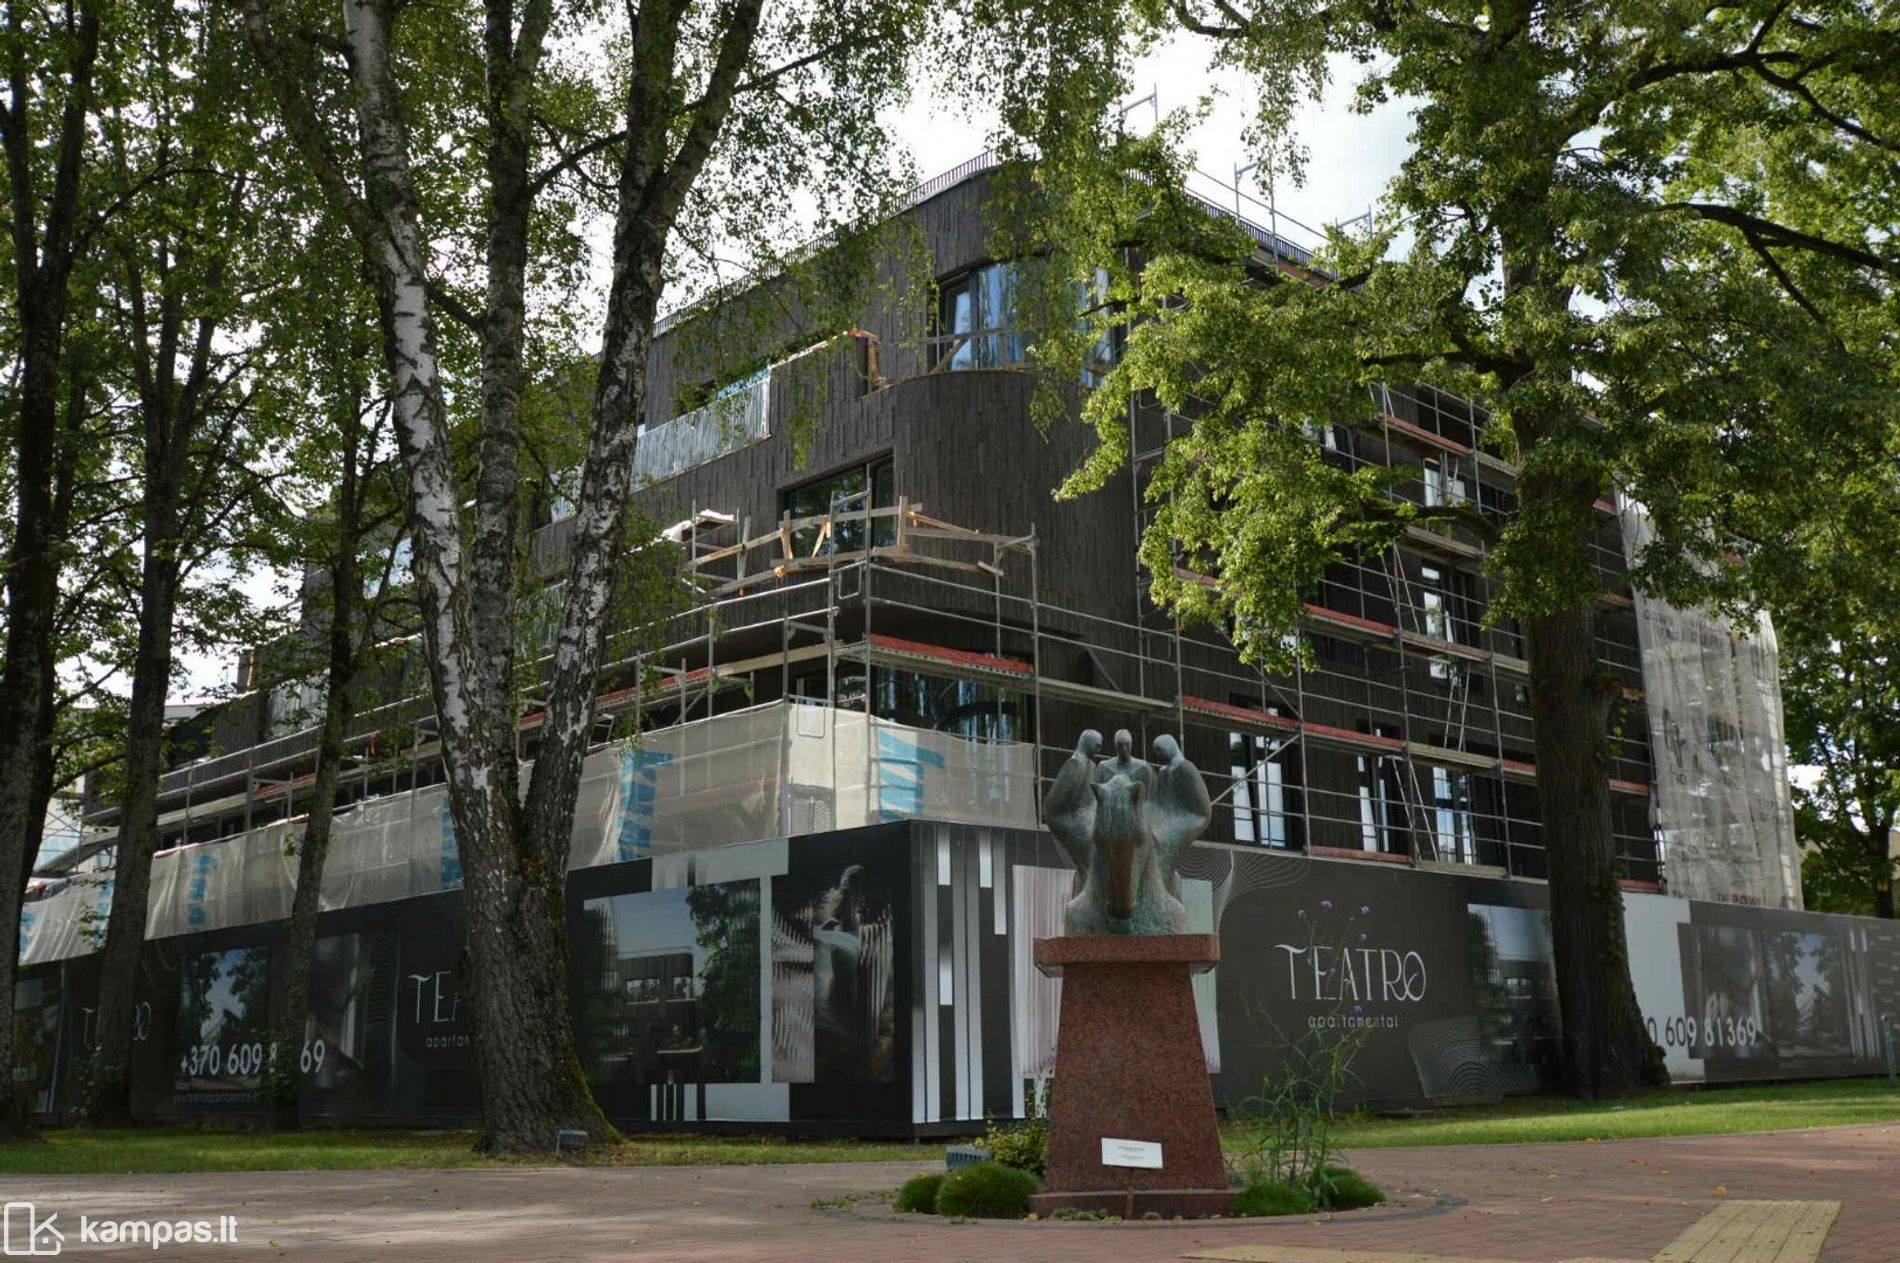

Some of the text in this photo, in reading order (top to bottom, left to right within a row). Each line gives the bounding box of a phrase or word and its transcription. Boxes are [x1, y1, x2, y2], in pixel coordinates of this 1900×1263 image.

[1274, 944, 1426, 1002] TEATRO
[1665, 1017, 1697, 1047] 609
[1704, 1017, 1757, 1047] 81369
[180, 1044, 220, 1076] +370
[227, 1042, 262, 1075] 609
